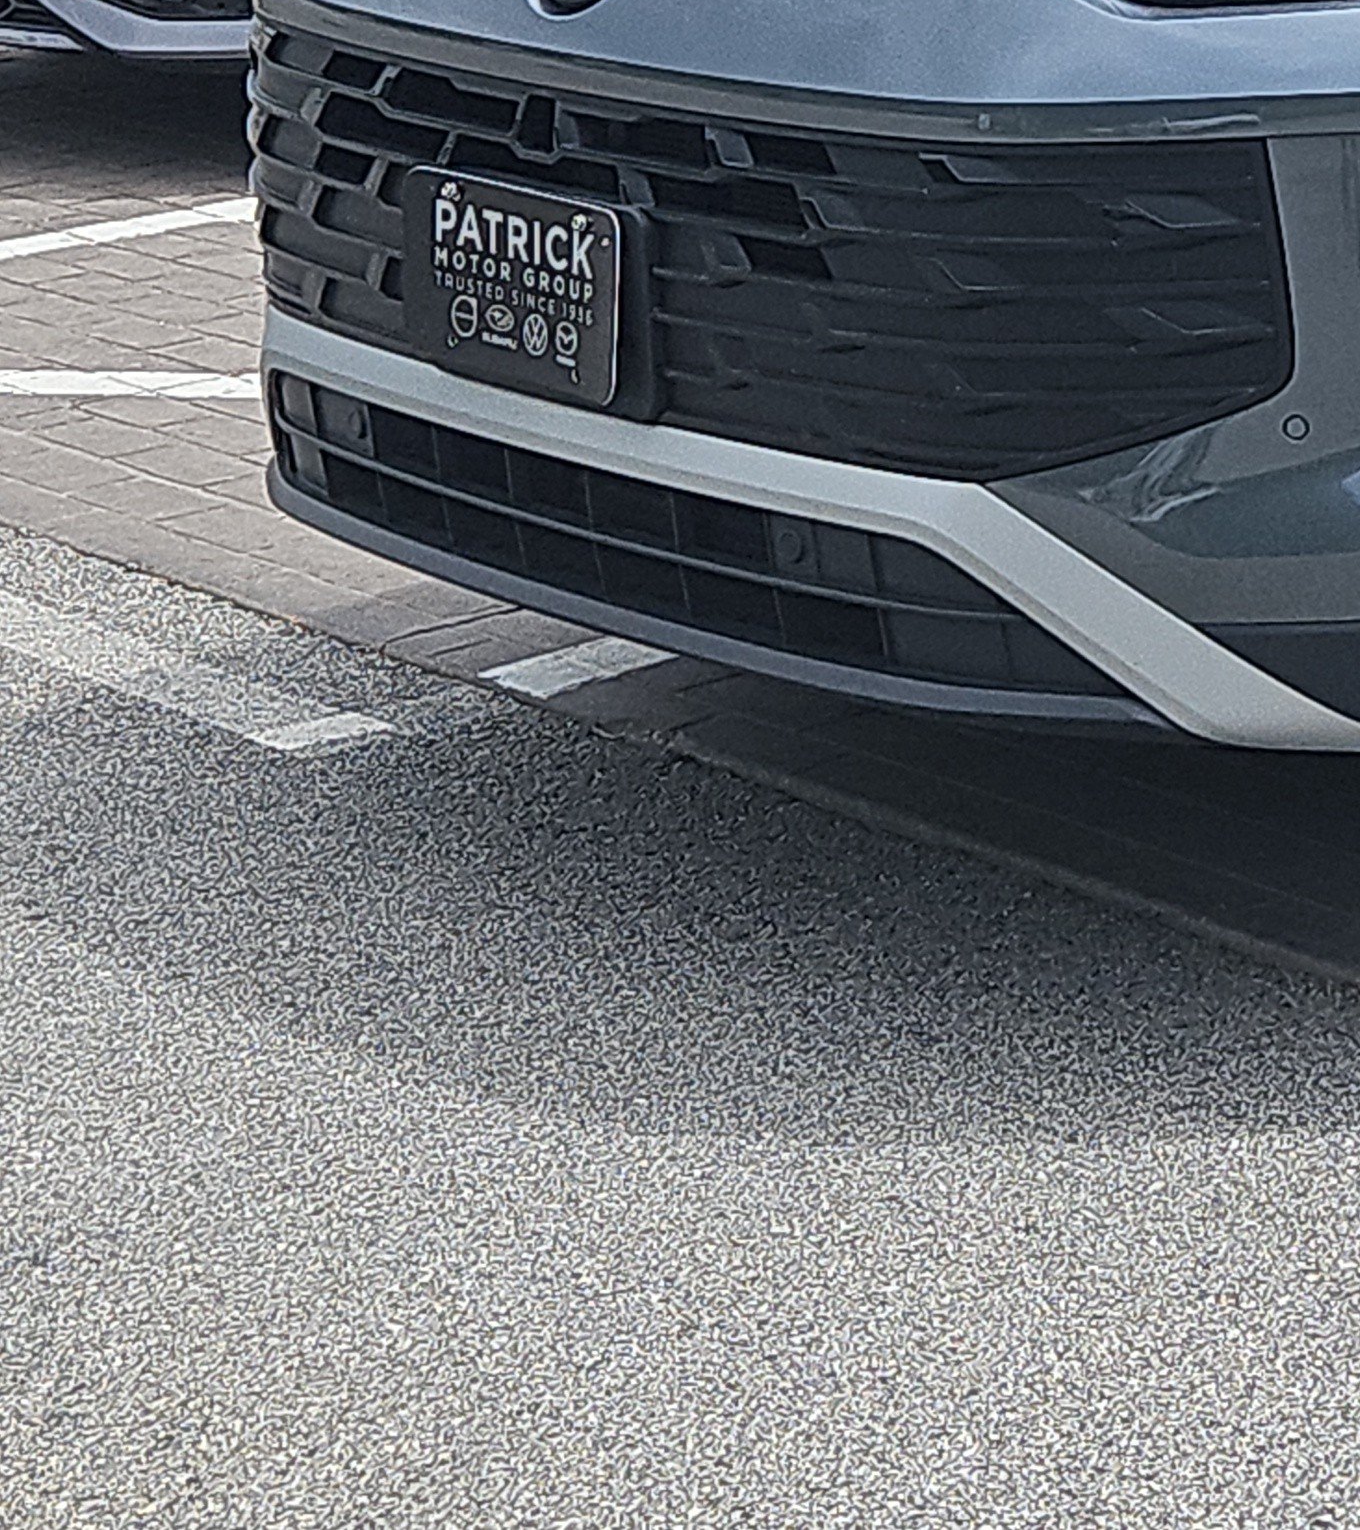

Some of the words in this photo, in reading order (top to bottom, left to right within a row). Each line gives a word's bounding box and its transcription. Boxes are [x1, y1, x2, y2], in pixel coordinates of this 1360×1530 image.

[434, 198, 596, 280] PATRICK
[433, 245, 512, 282] MOTOR
[522, 267, 594, 304] GROUP
[433, 270, 504, 300] TRUSTED
[511, 289, 556, 316] SINCE
